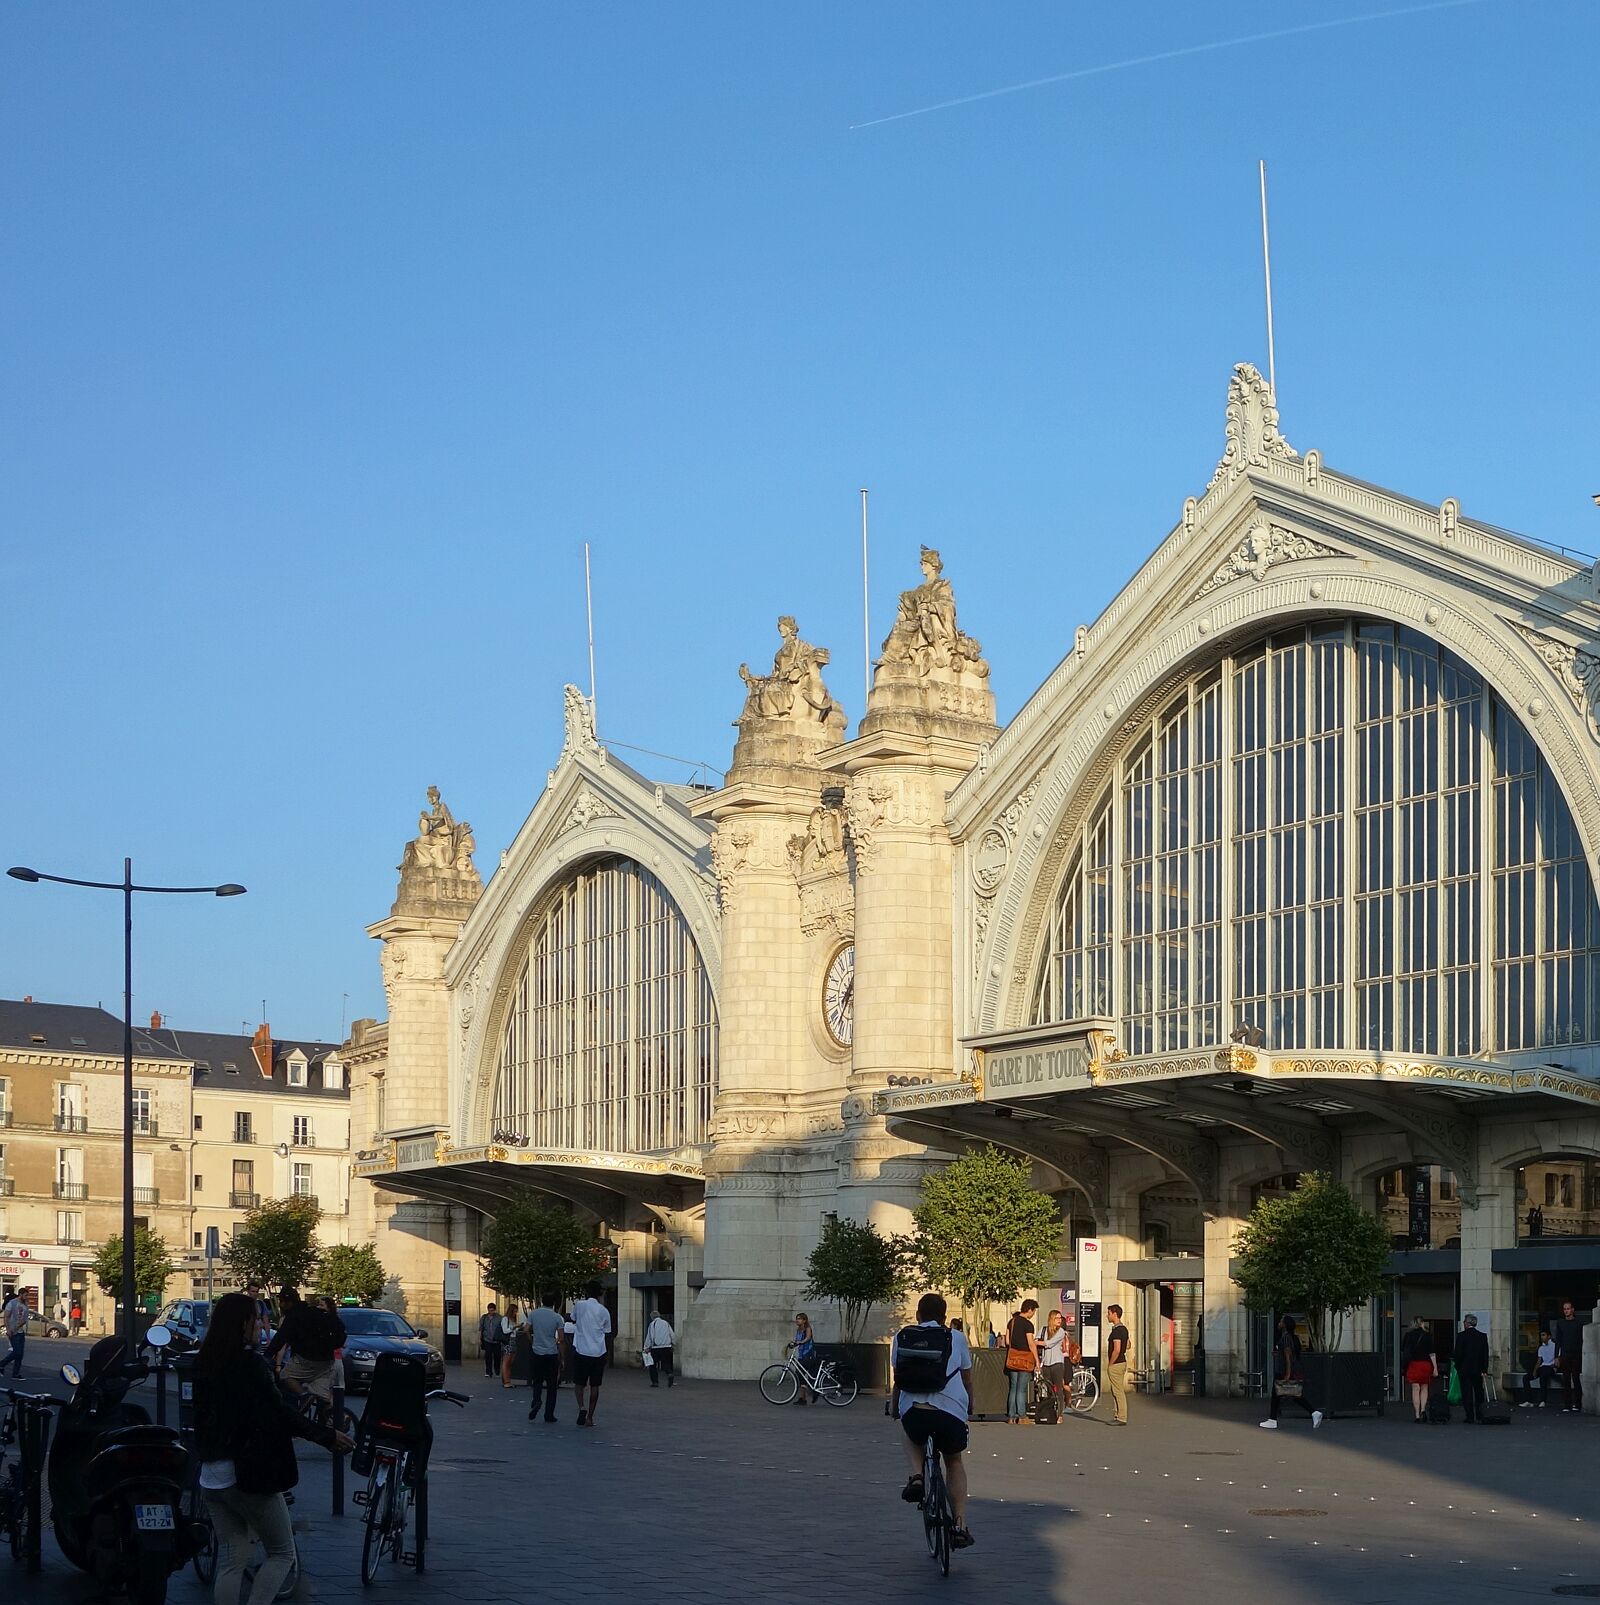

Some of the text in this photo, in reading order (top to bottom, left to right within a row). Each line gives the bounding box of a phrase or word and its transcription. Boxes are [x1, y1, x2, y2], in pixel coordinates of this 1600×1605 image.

[988, 1047, 1090, 1088] GARE DE TOURS
